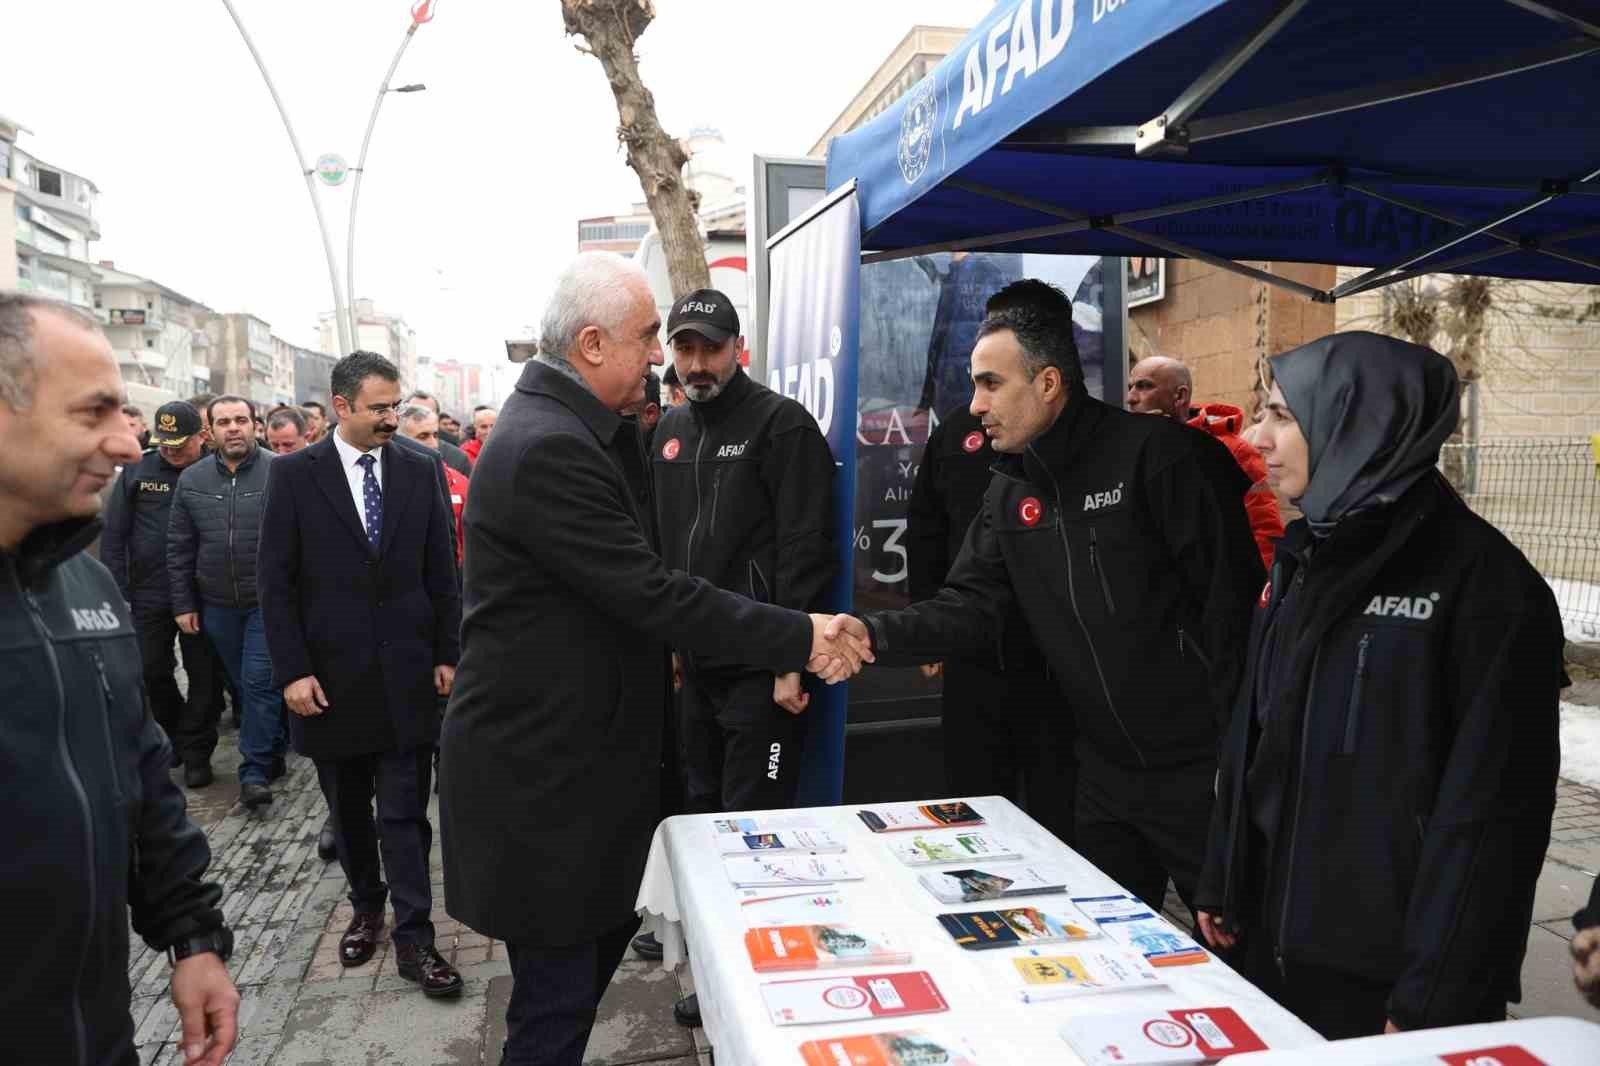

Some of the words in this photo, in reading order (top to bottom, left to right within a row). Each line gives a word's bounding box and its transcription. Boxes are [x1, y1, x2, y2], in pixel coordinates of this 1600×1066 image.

[953, 0, 1076, 131] AFAD
[680, 300, 715, 315] AFAD
[716, 443, 746, 457] AFAD
[1083, 487, 1122, 511] AFAD
[70, 606, 121, 631] AFAD
[1363, 595, 1435, 620] AFAD
[767, 742, 781, 780] AFAD
